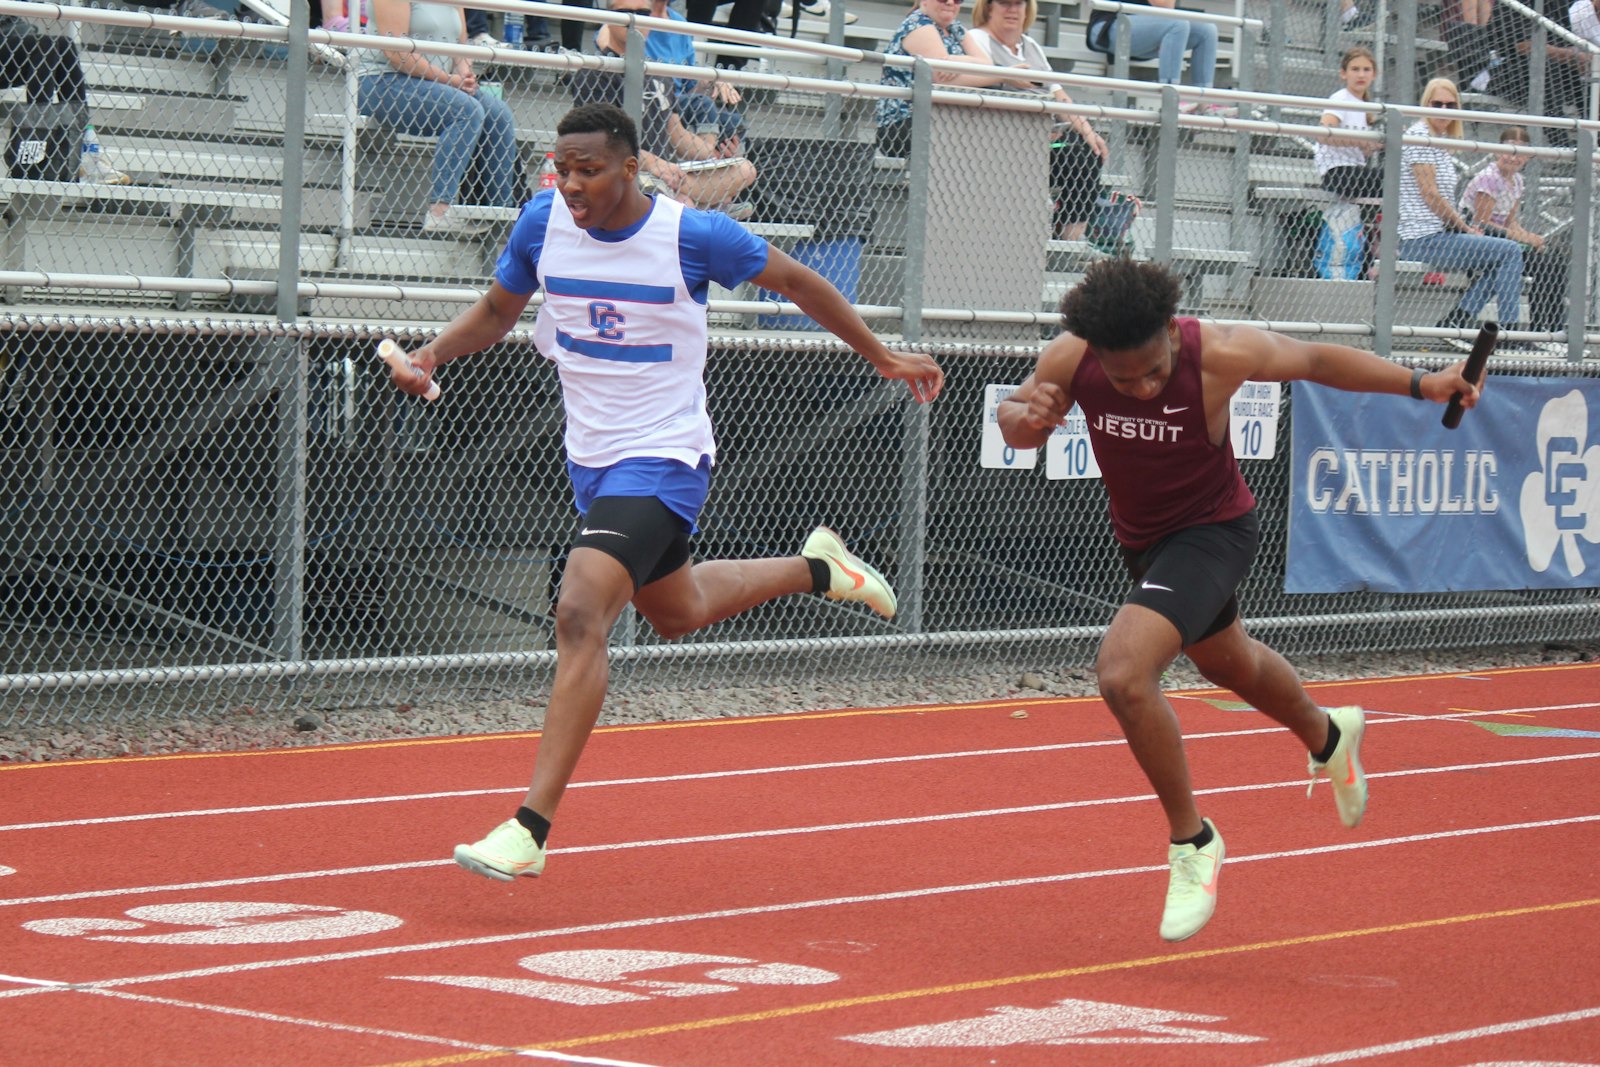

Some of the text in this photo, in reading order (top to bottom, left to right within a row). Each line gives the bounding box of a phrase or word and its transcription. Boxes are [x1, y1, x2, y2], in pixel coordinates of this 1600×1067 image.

[1105, 413, 1136, 423] UNIVERSITY
[1145, 418, 1168, 427] DETROIT
[1233, 402, 1275, 418] HURDLE RACE
[1093, 415, 1184, 443] JESUIT
[1241, 420, 1262, 456] 10
[1064, 438, 1088, 476] 10
[1306, 446, 1500, 516] CATHOLIC
